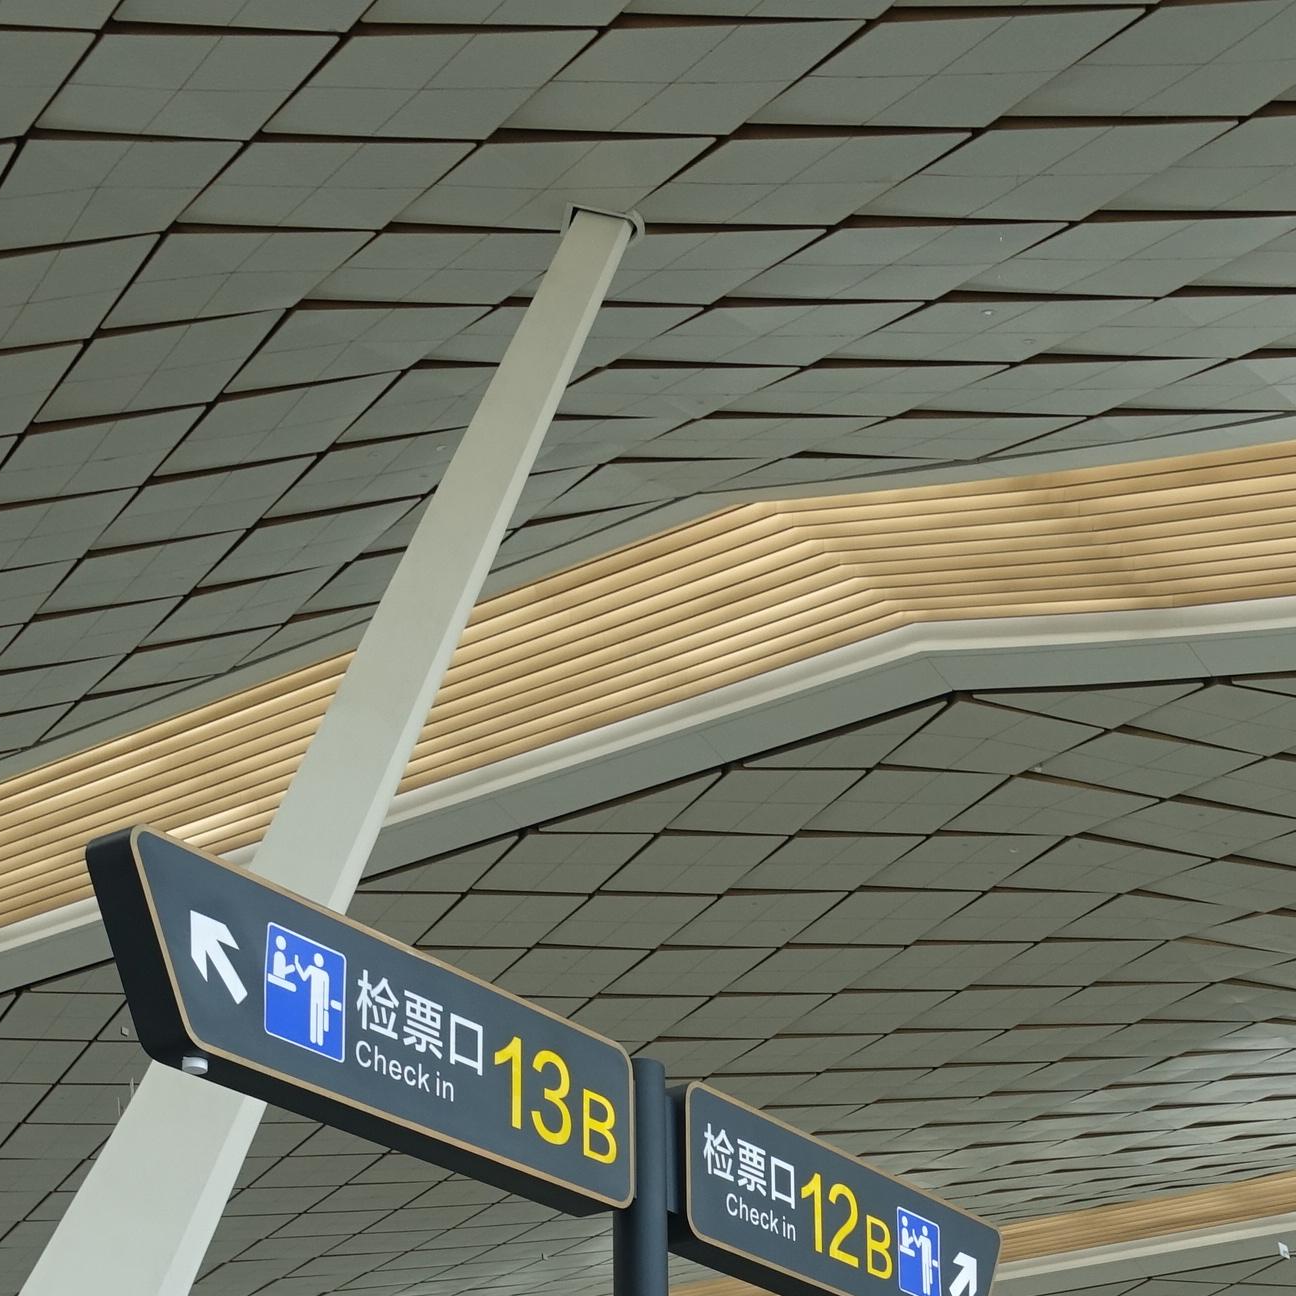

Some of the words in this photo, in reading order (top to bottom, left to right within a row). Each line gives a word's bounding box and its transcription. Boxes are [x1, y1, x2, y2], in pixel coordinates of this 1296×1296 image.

[355, 1039, 430, 1093] Check
[435, 1071, 455, 1102] in
[356, 968, 484, 1077] 检票口
[494, 1035, 618, 1165] 13B
[703, 1122, 796, 1210] 检票口
[801, 1172, 893, 1280] 12B
[726, 1192, 779, 1233] Check
[782, 1216, 796, 1242] in
